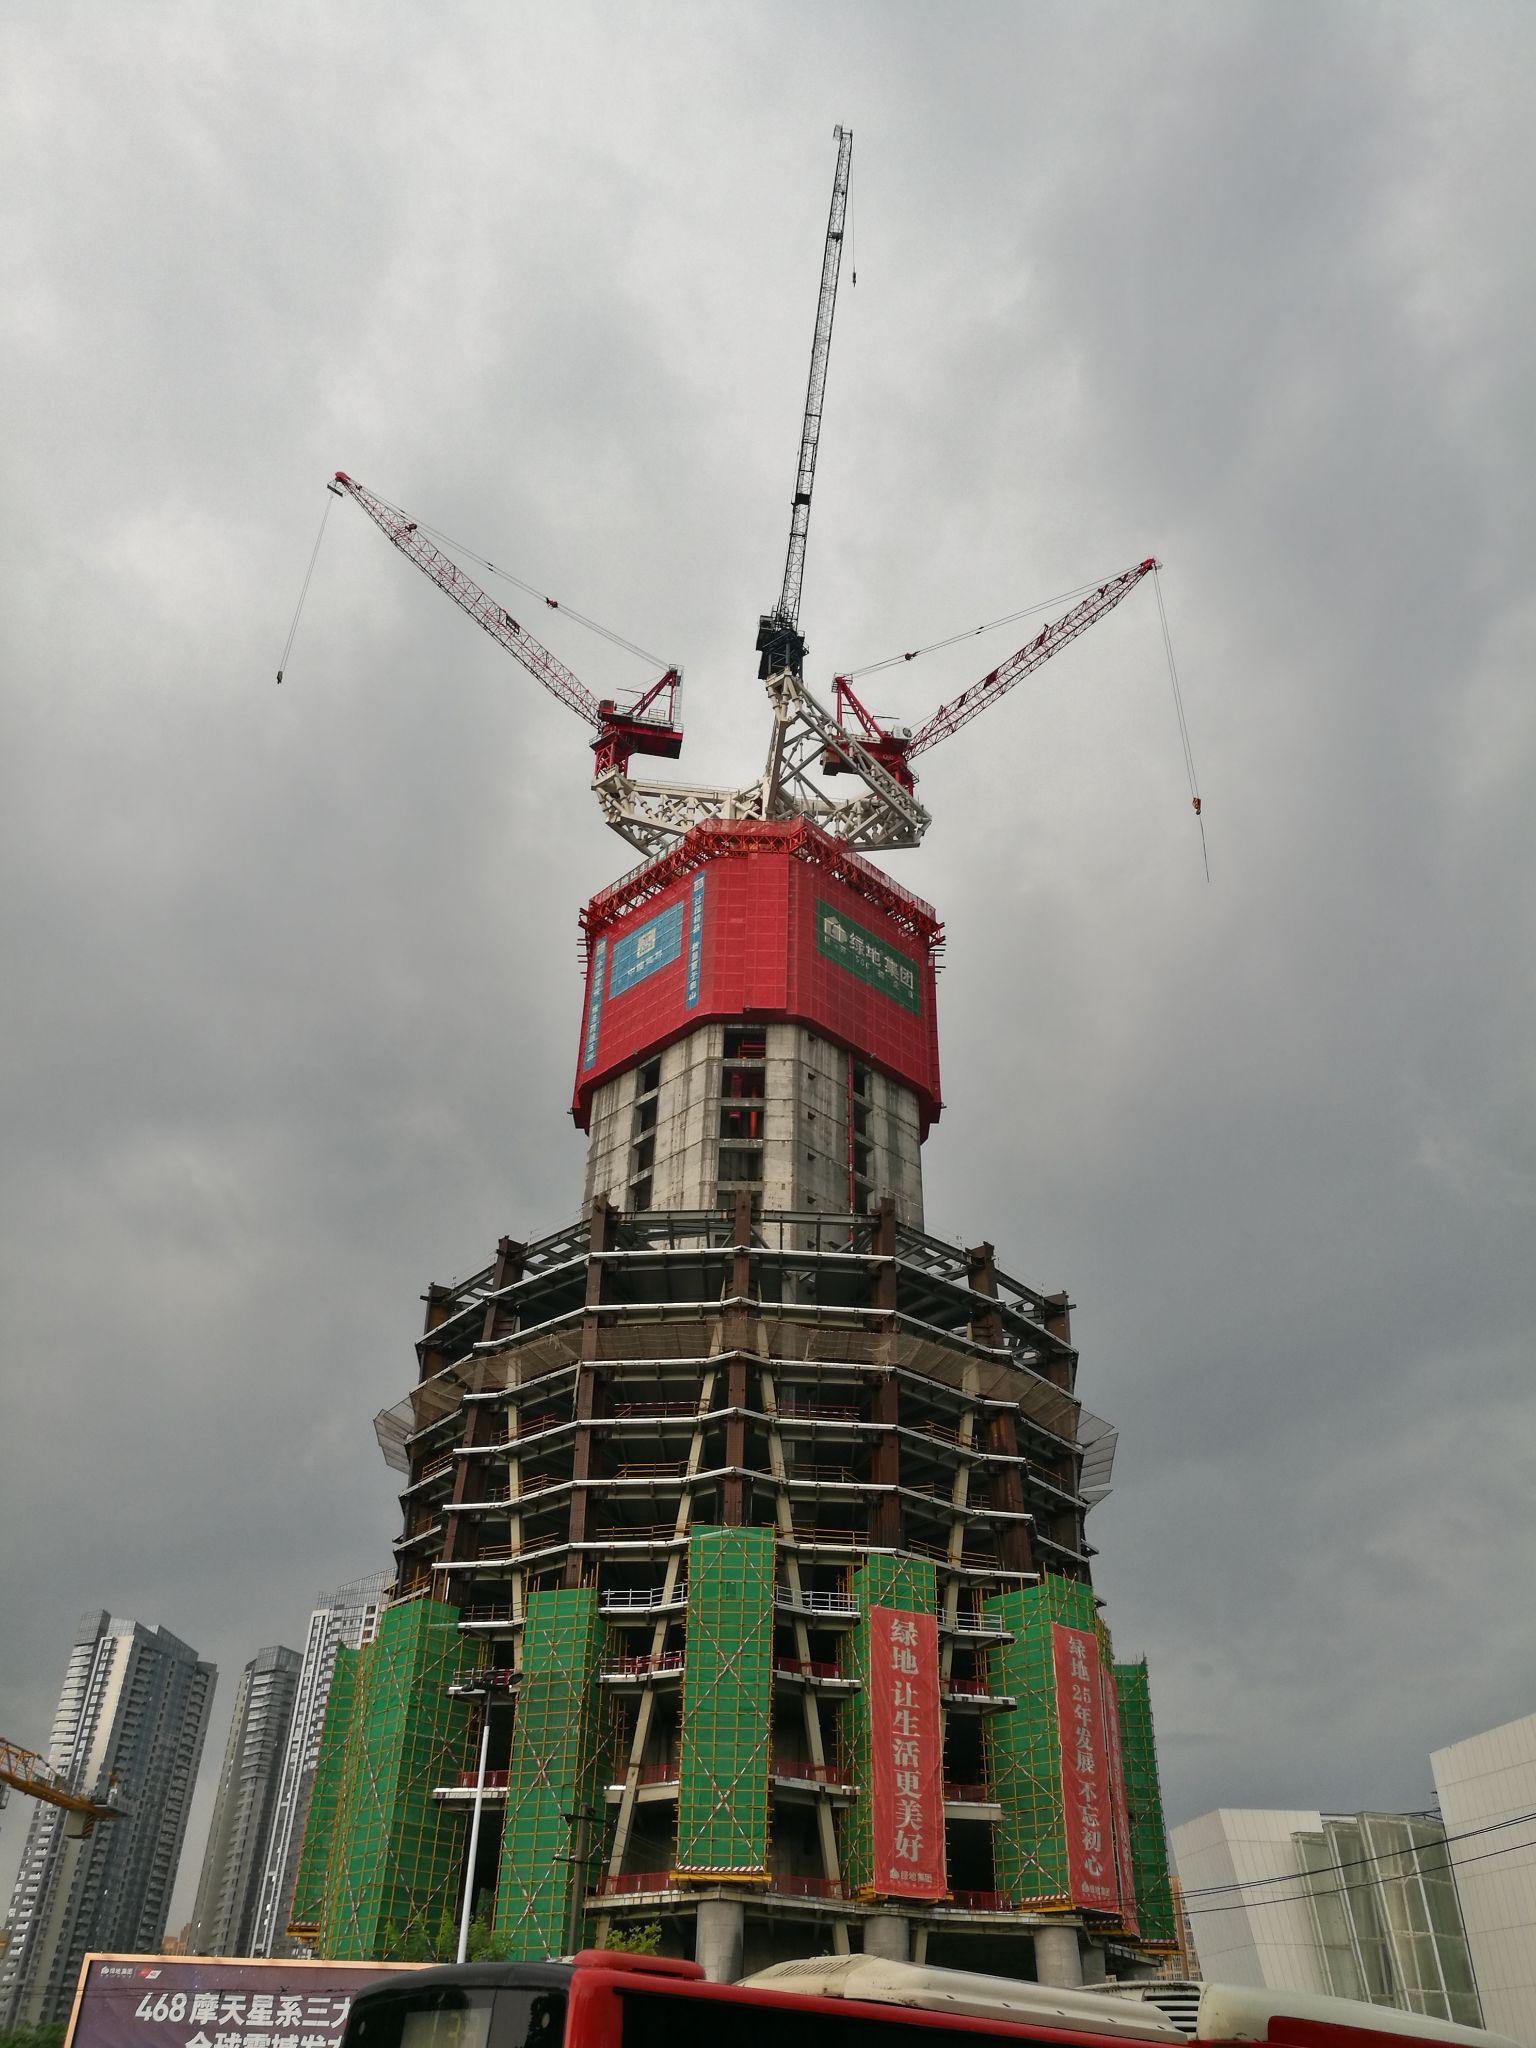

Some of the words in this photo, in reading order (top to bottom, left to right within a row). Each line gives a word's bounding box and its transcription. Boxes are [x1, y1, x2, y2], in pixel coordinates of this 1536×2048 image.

[849, 930, 914, 989] 绿地集团
[889, 1618, 924, 1863] 绿地让生活更美好
[900, 1870, 933, 1883] 绿地集团
